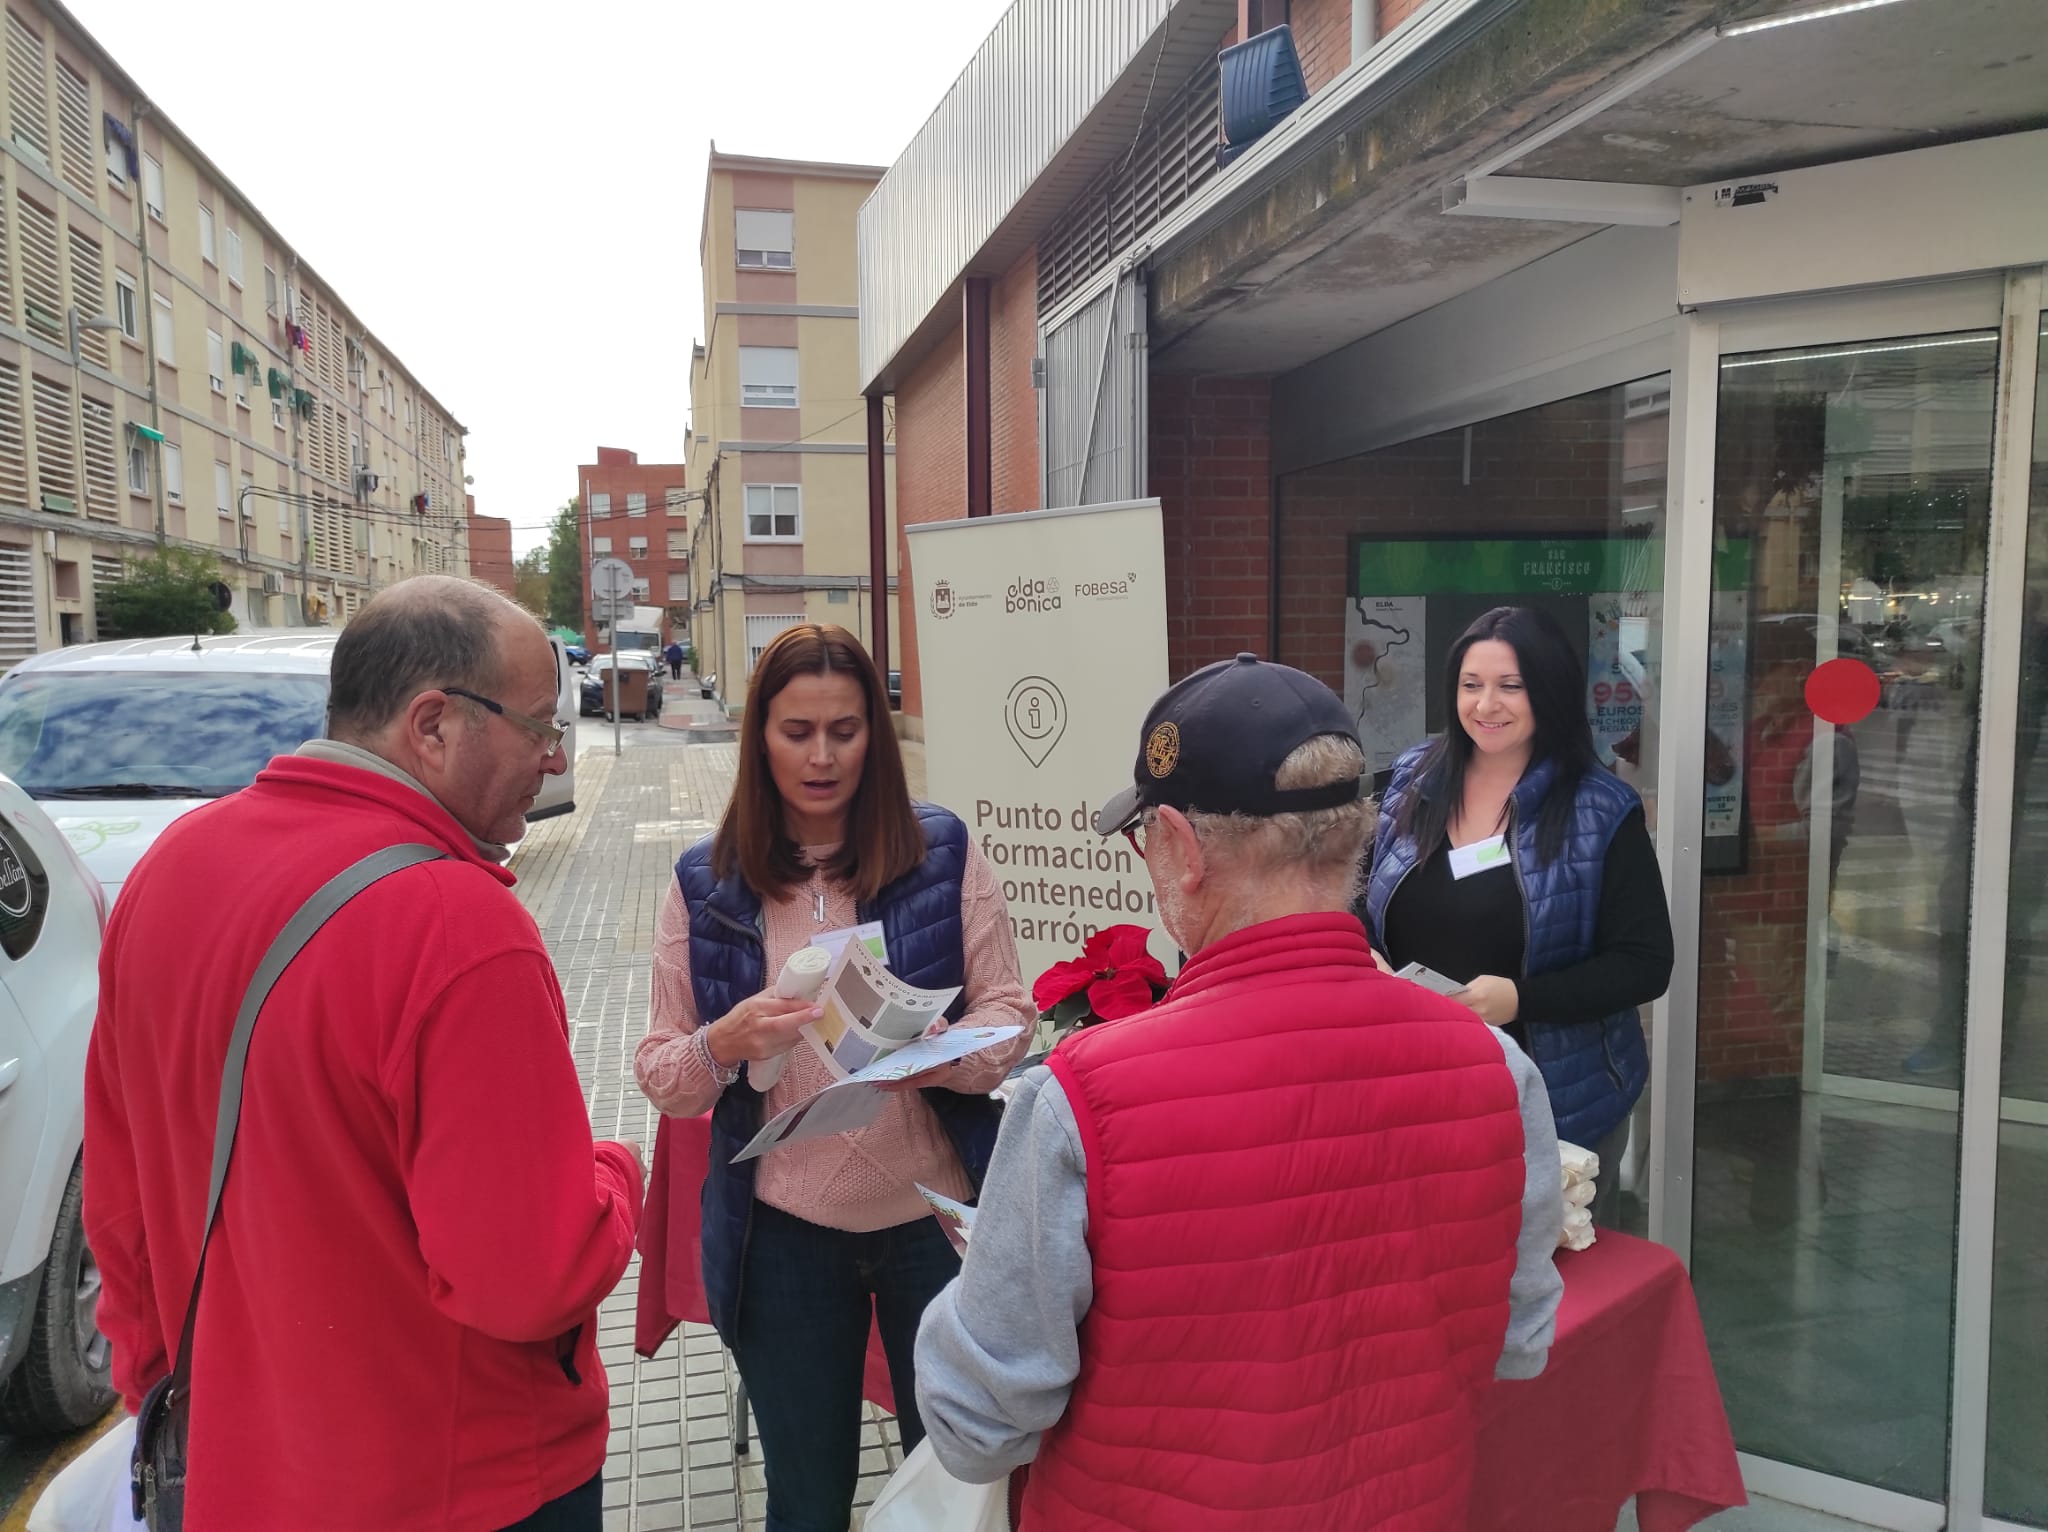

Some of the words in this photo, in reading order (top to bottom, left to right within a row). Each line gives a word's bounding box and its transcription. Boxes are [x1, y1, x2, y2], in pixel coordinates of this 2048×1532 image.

[1523, 561, 1590, 576] FRANCISCO
[1008, 576, 1045, 598] elda
[1006, 596, 1062, 613] bonica
[1593, 682, 1633, 704] 95
[1598, 705, 1644, 716] EUROS
[1605, 717, 1640, 725] CHEQU
[976, 799, 1062, 831] Punto
[1071, 801, 1101, 832] de
[981, 834, 1132, 873] formación
[1001, 878, 1155, 914] ontenedor
[1010, 911, 1098, 945] arrón
